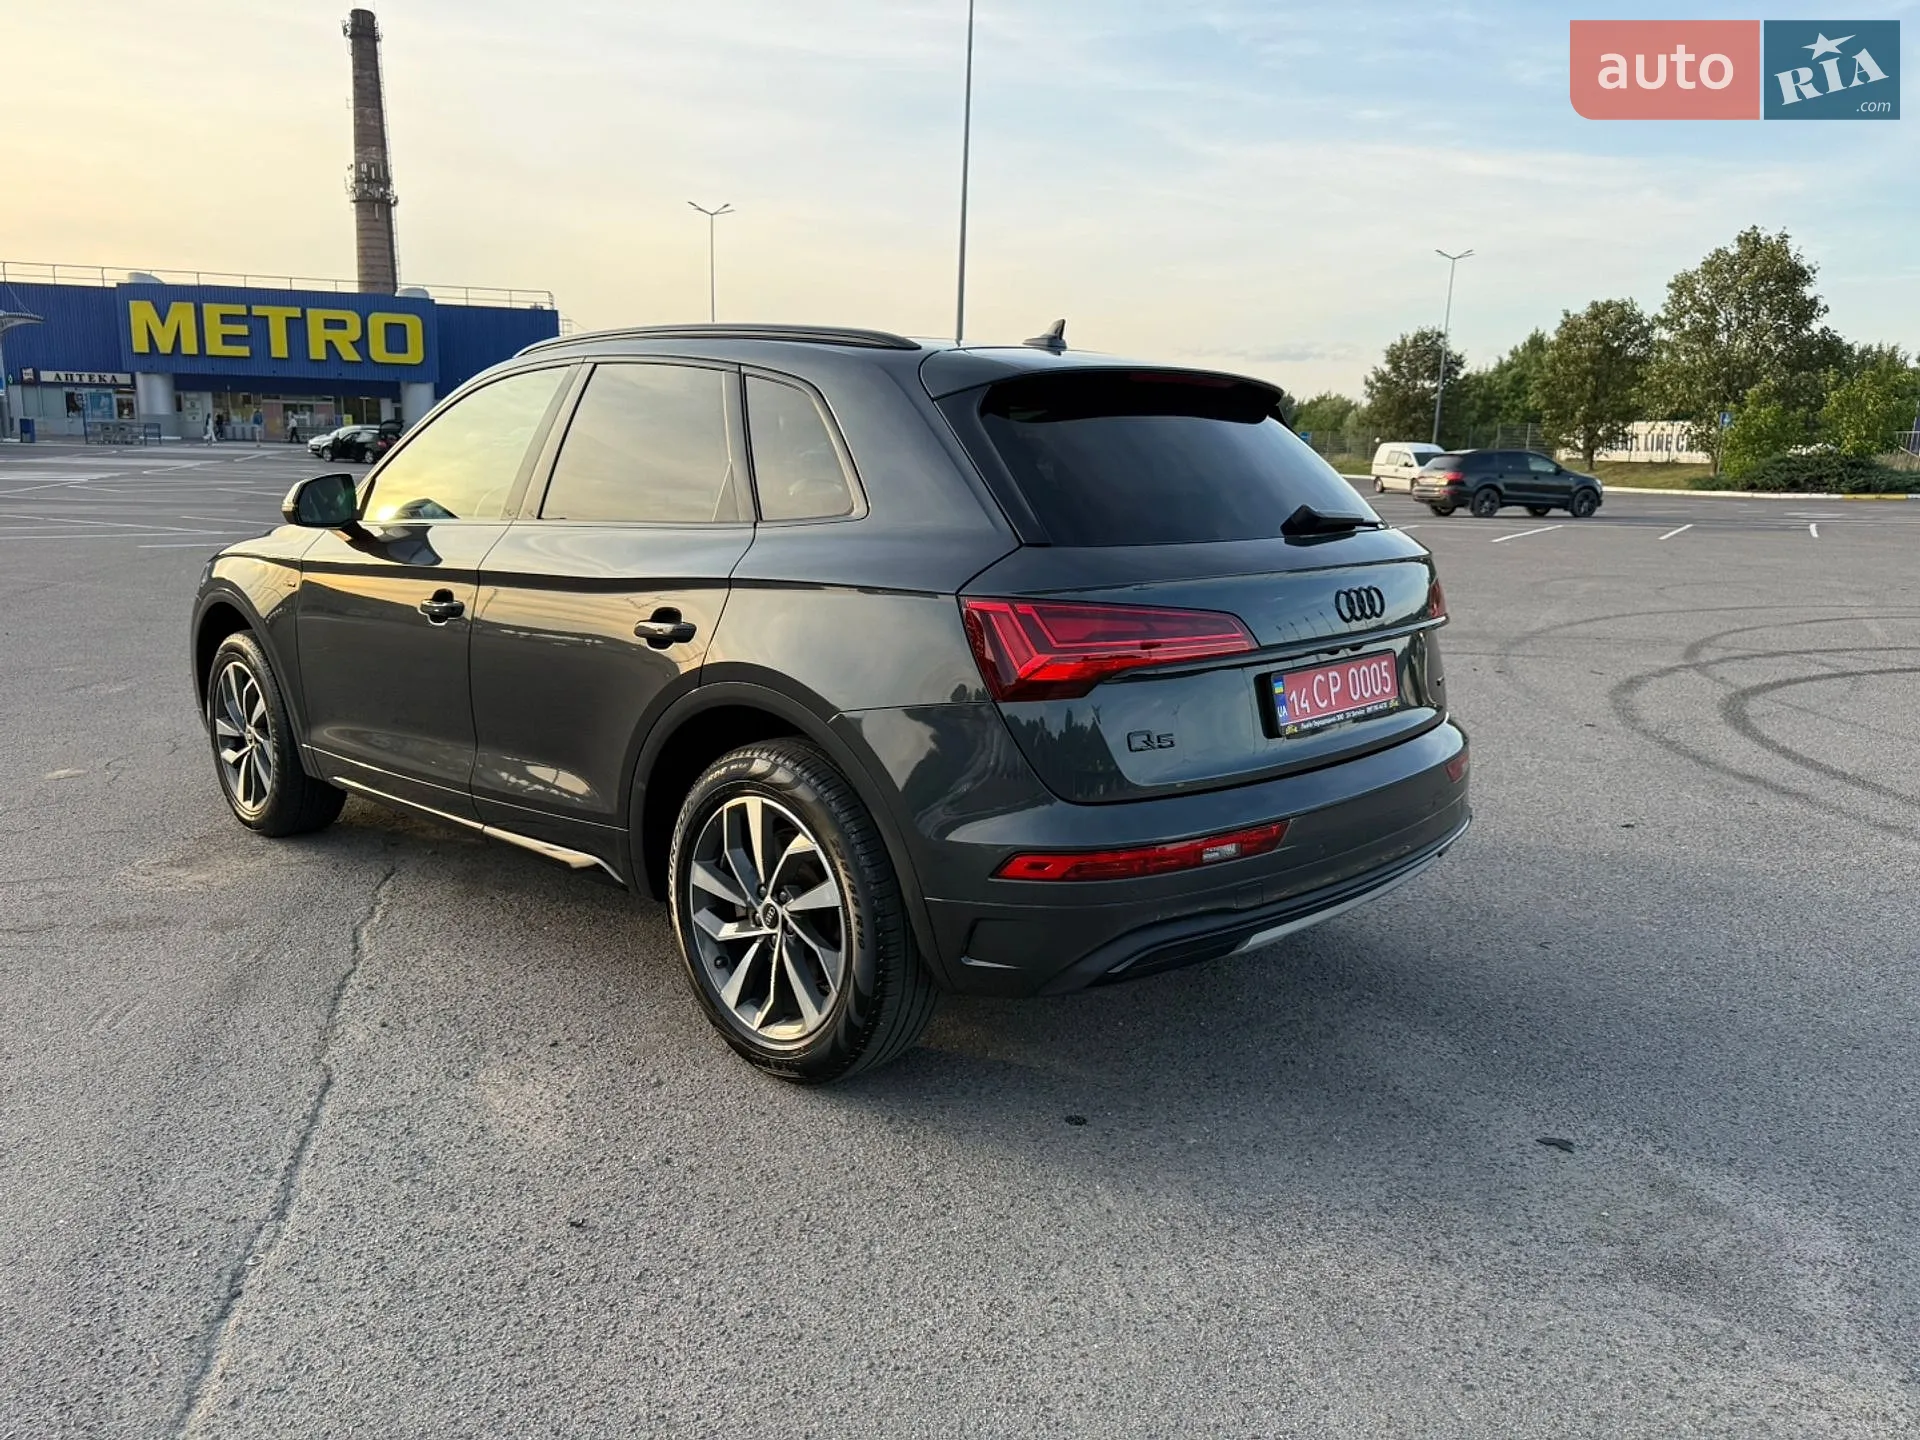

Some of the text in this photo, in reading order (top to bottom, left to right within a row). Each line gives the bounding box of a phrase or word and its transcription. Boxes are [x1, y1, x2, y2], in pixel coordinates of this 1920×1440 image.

[129, 300, 424, 365] METRO
[54, 372, 118, 385] АПТЕКА
[1289, 687, 1310, 716] 14
[1313, 674, 1341, 708] CP
[1348, 661, 1391, 701] 0005
[1277, 705, 1288, 718] UA
[1127, 730, 1175, 752] Q5
